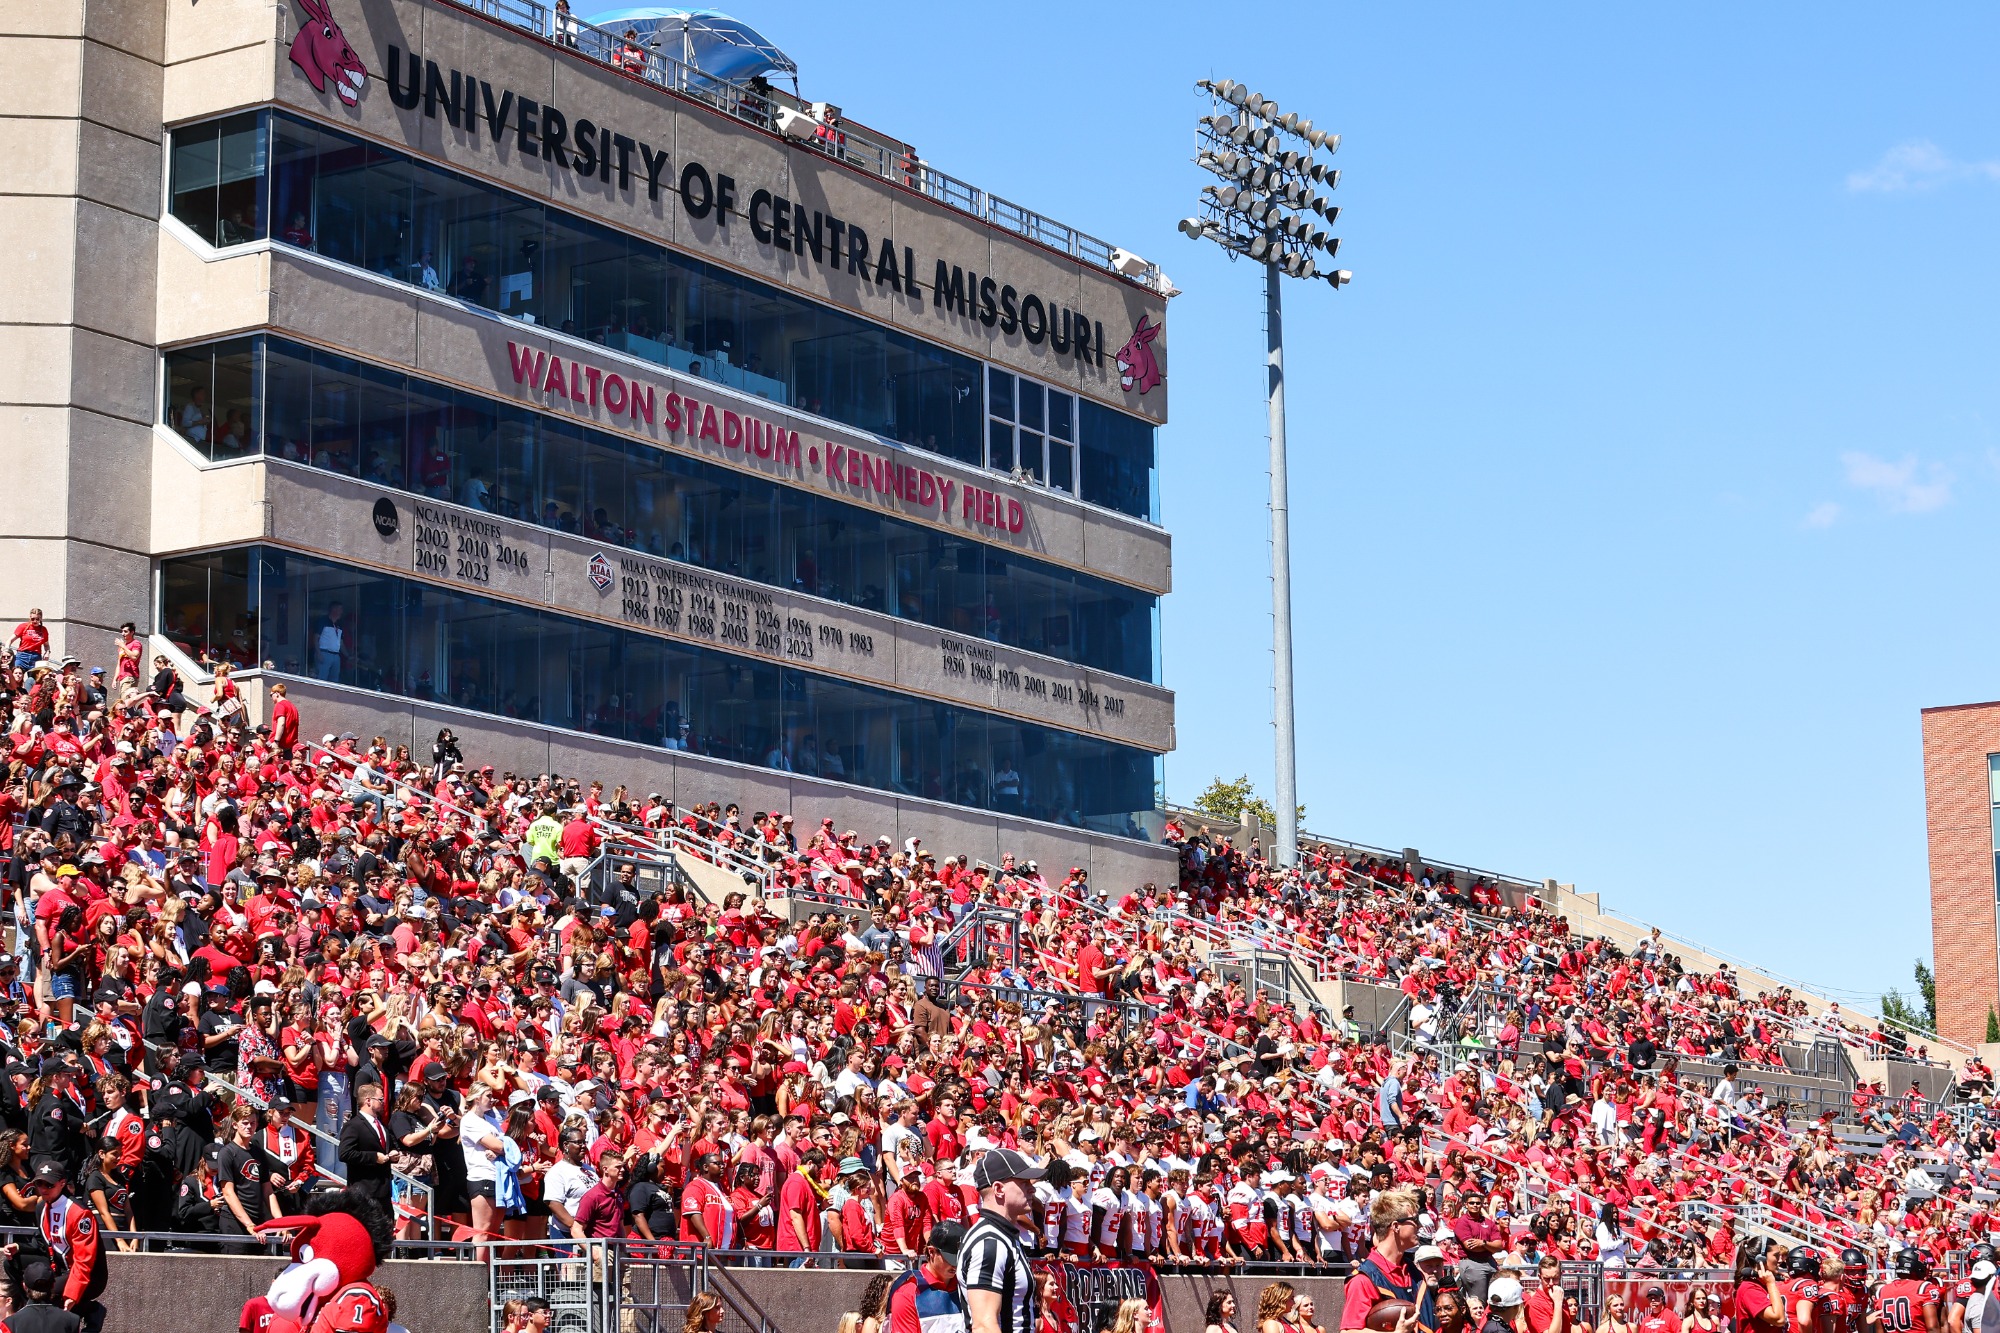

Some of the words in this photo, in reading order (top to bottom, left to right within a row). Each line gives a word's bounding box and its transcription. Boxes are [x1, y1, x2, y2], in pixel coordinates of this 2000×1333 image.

[387, 44, 669, 202] UNIVERSITY
[680, 162, 735, 227] OF
[749, 188, 922, 300] CENTRAL
[933, 259, 1103, 368] MISSOURI
[508, 341, 654, 425] WALTON
[664, 392, 800, 468] STADIUM
[825, 442, 956, 513] KENNEDY
[962, 485, 1024, 534] FIELD
[375, 514, 397, 528] NCAA
[416, 506, 448, 526] NCAA
[451, 514, 501, 539] PLAYOFFS
[416, 525, 449, 549] 2002
[457, 536, 489, 559] 2010
[496, 545, 528, 569] 2016
[416, 549, 447, 572] 2019
[457, 559, 489, 582] 2023
[590, 564, 612, 579] MIAA
[621, 558, 648, 576] MIAA
[649, 565, 713, 592] CONFERENCE
[716, 582, 772, 606] CHAMPIONS
[621, 576, 649, 597] 1912
[656, 585, 682, 605] 1913
[690, 593, 716, 614] 1914
[723, 601, 748, 621] 1915
[755, 609, 780, 630] 1926
[787, 617, 812, 637] 1956
[819, 625, 842, 645] 1970
[849, 632, 873, 652] 1983
[621, 599, 649, 620] 1986
[653, 606, 680, 627] 1987
[687, 614, 714, 635] 1988
[721, 622, 748, 642] 2003
[755, 630, 780, 650] 2019
[787, 638, 813, 658] 2023
[941, 638, 965, 654] BOWL
[966, 645, 993, 662] GAMES
[942, 655, 965, 673] 1950
[971, 662, 992, 680] 1968
[998, 669, 1019, 688] 1970
[1024, 675, 1047, 695] 2001
[1052, 682, 1072, 701] 2011
[1078, 688, 1099, 707] 2014
[1104, 695, 1124, 714] 2017
[534, 824, 555, 832] EVENT
[536, 831, 552, 839] STAFF
[1063, 1262, 1147, 1304] ROARING
[353, 1304, 364, 1325] 1
[1881, 1295, 1912, 1333] 50
